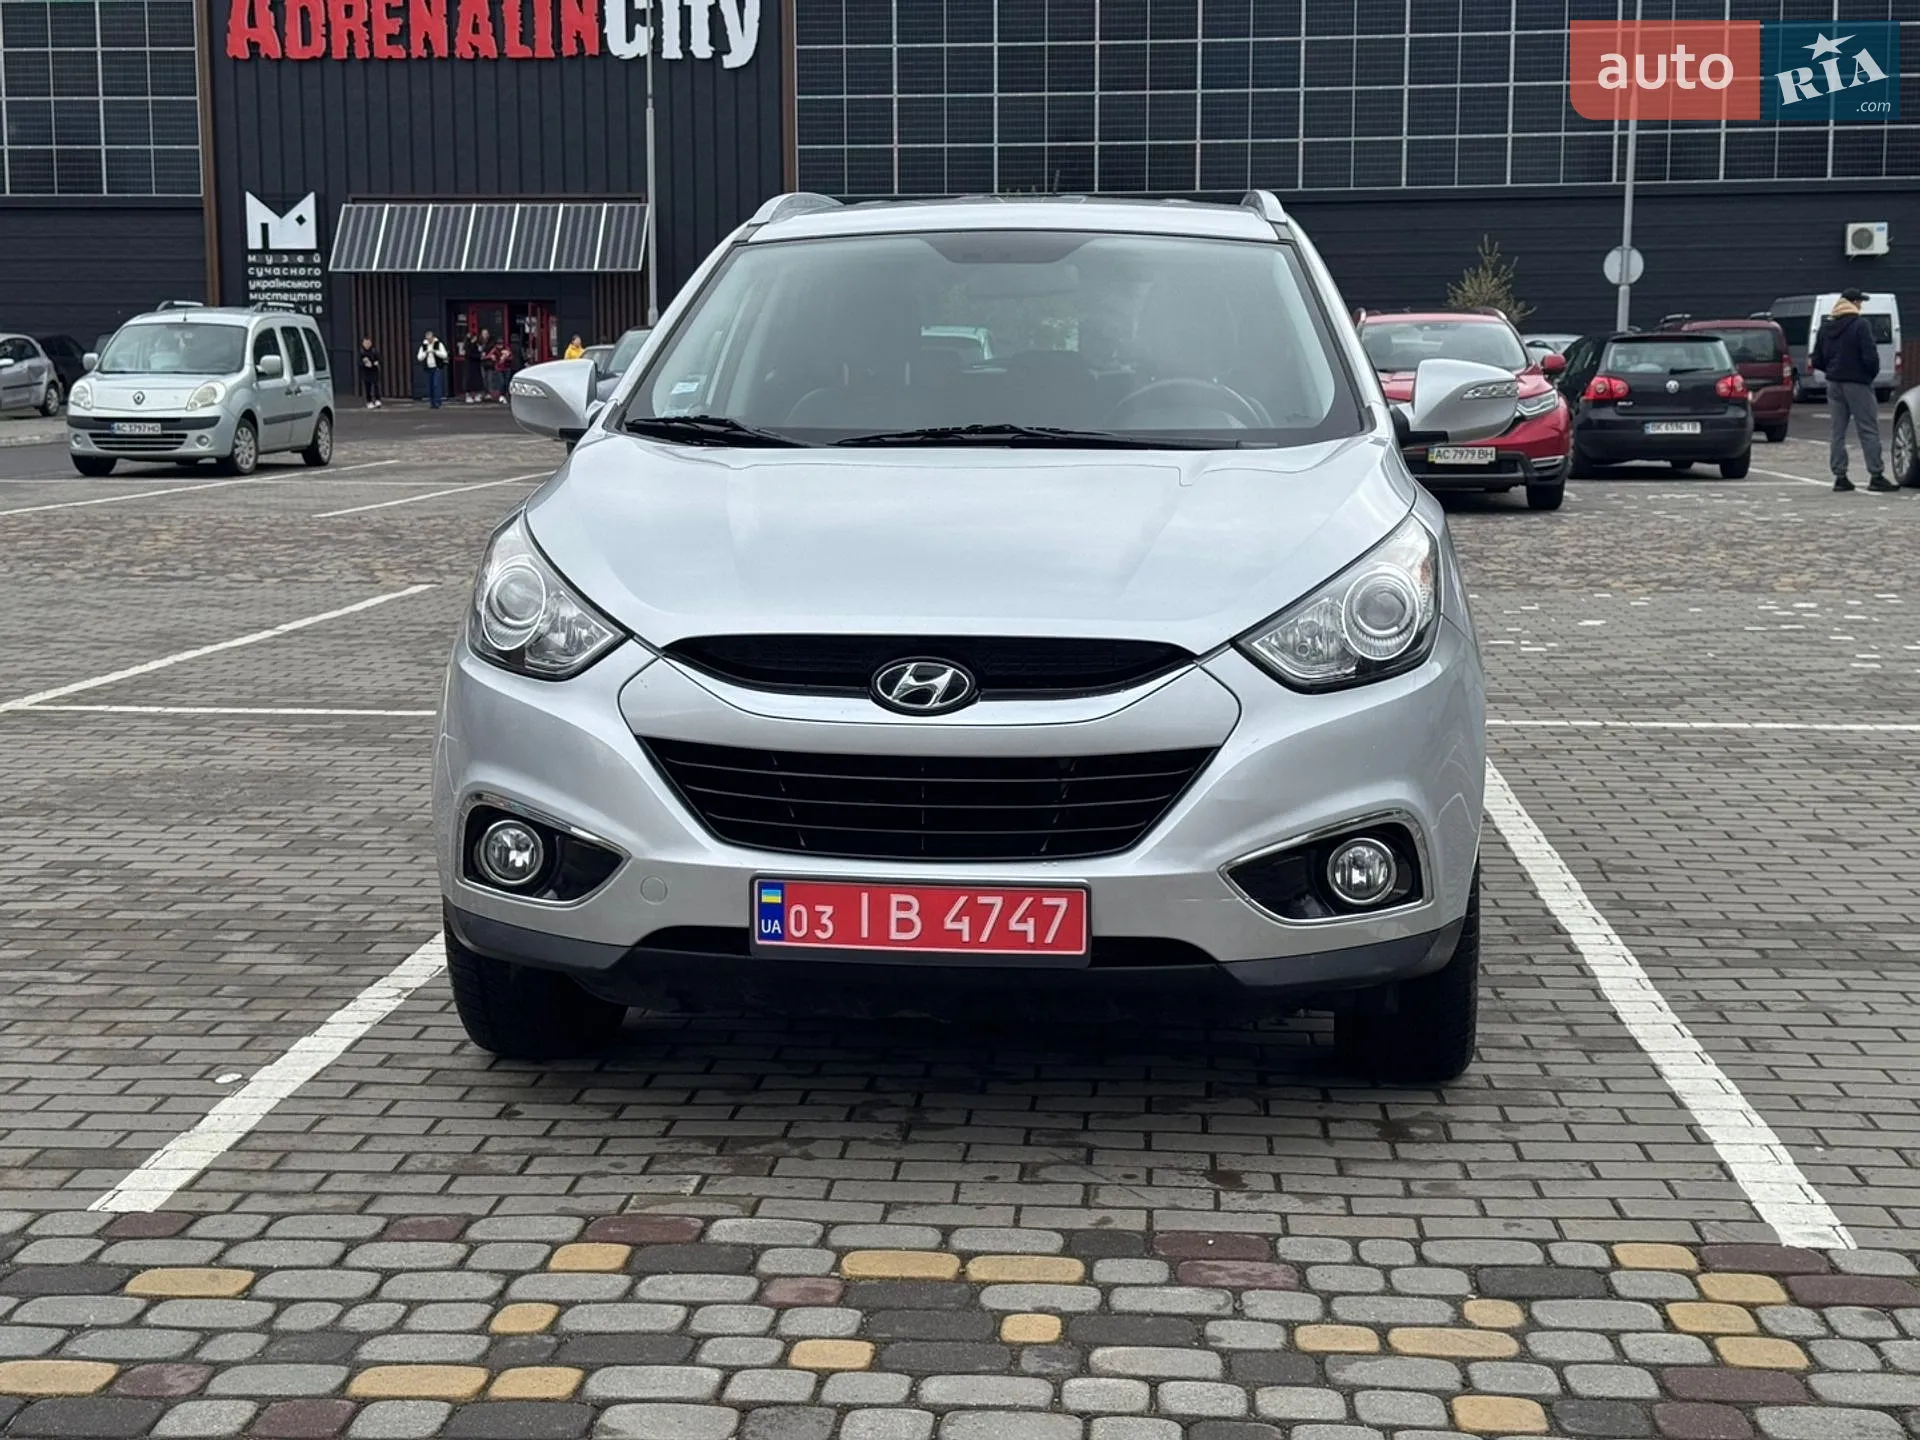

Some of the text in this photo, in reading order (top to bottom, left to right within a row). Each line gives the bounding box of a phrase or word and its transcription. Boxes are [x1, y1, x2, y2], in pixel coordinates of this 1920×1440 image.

[247, 252, 322, 265] музей
[247, 266, 322, 278] сучасного
[248, 278, 323, 291] українського
[249, 292, 323, 303] мистецтва
[1435, 449, 1450, 460] AC
[1451, 449, 1477, 460] 7979
[788, 892, 1069, 944] 03 IB 4747
[761, 919, 782, 934] UA
